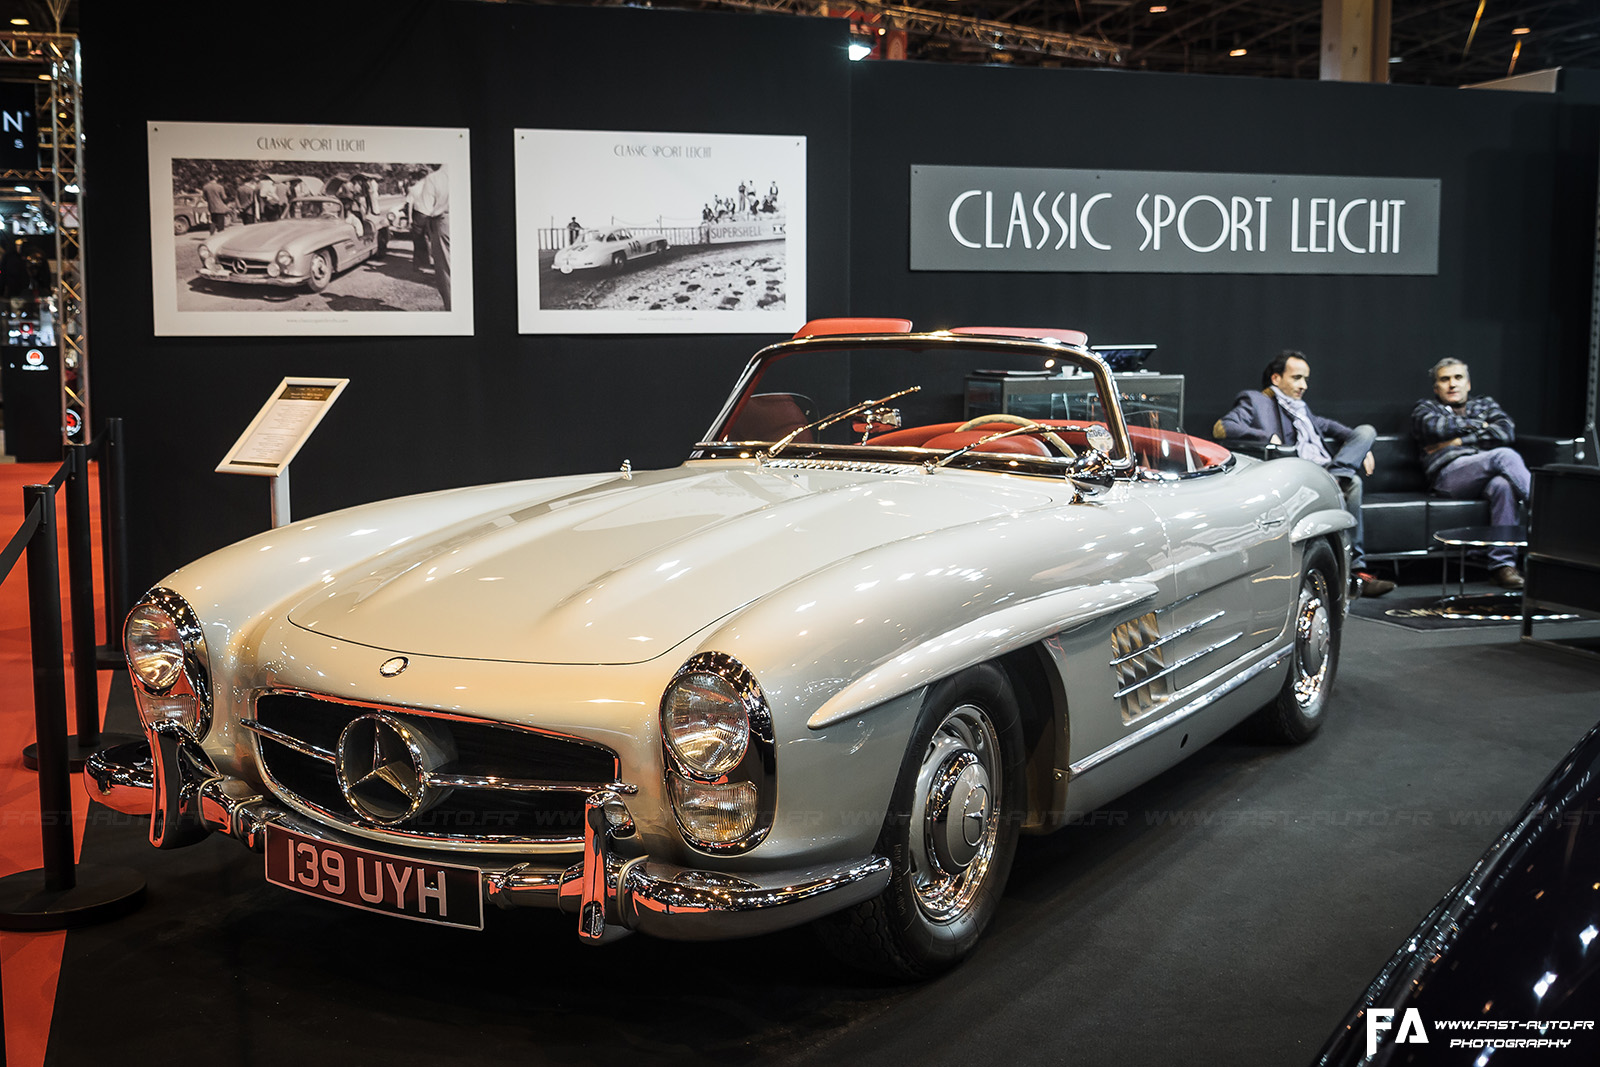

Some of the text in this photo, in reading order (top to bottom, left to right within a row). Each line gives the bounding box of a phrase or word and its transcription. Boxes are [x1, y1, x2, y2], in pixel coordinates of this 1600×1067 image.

[257, 136, 366, 152] CLASSIC SPORT LEICHT
[614, 144, 712, 158] CLASSIC SPORT LEICHT
[948, 189, 1406, 254] CLASSIC SPORT LEICHT
[711, 225, 762, 239] SUPERSHELL
[288, 838, 447, 917] 139 UYH
